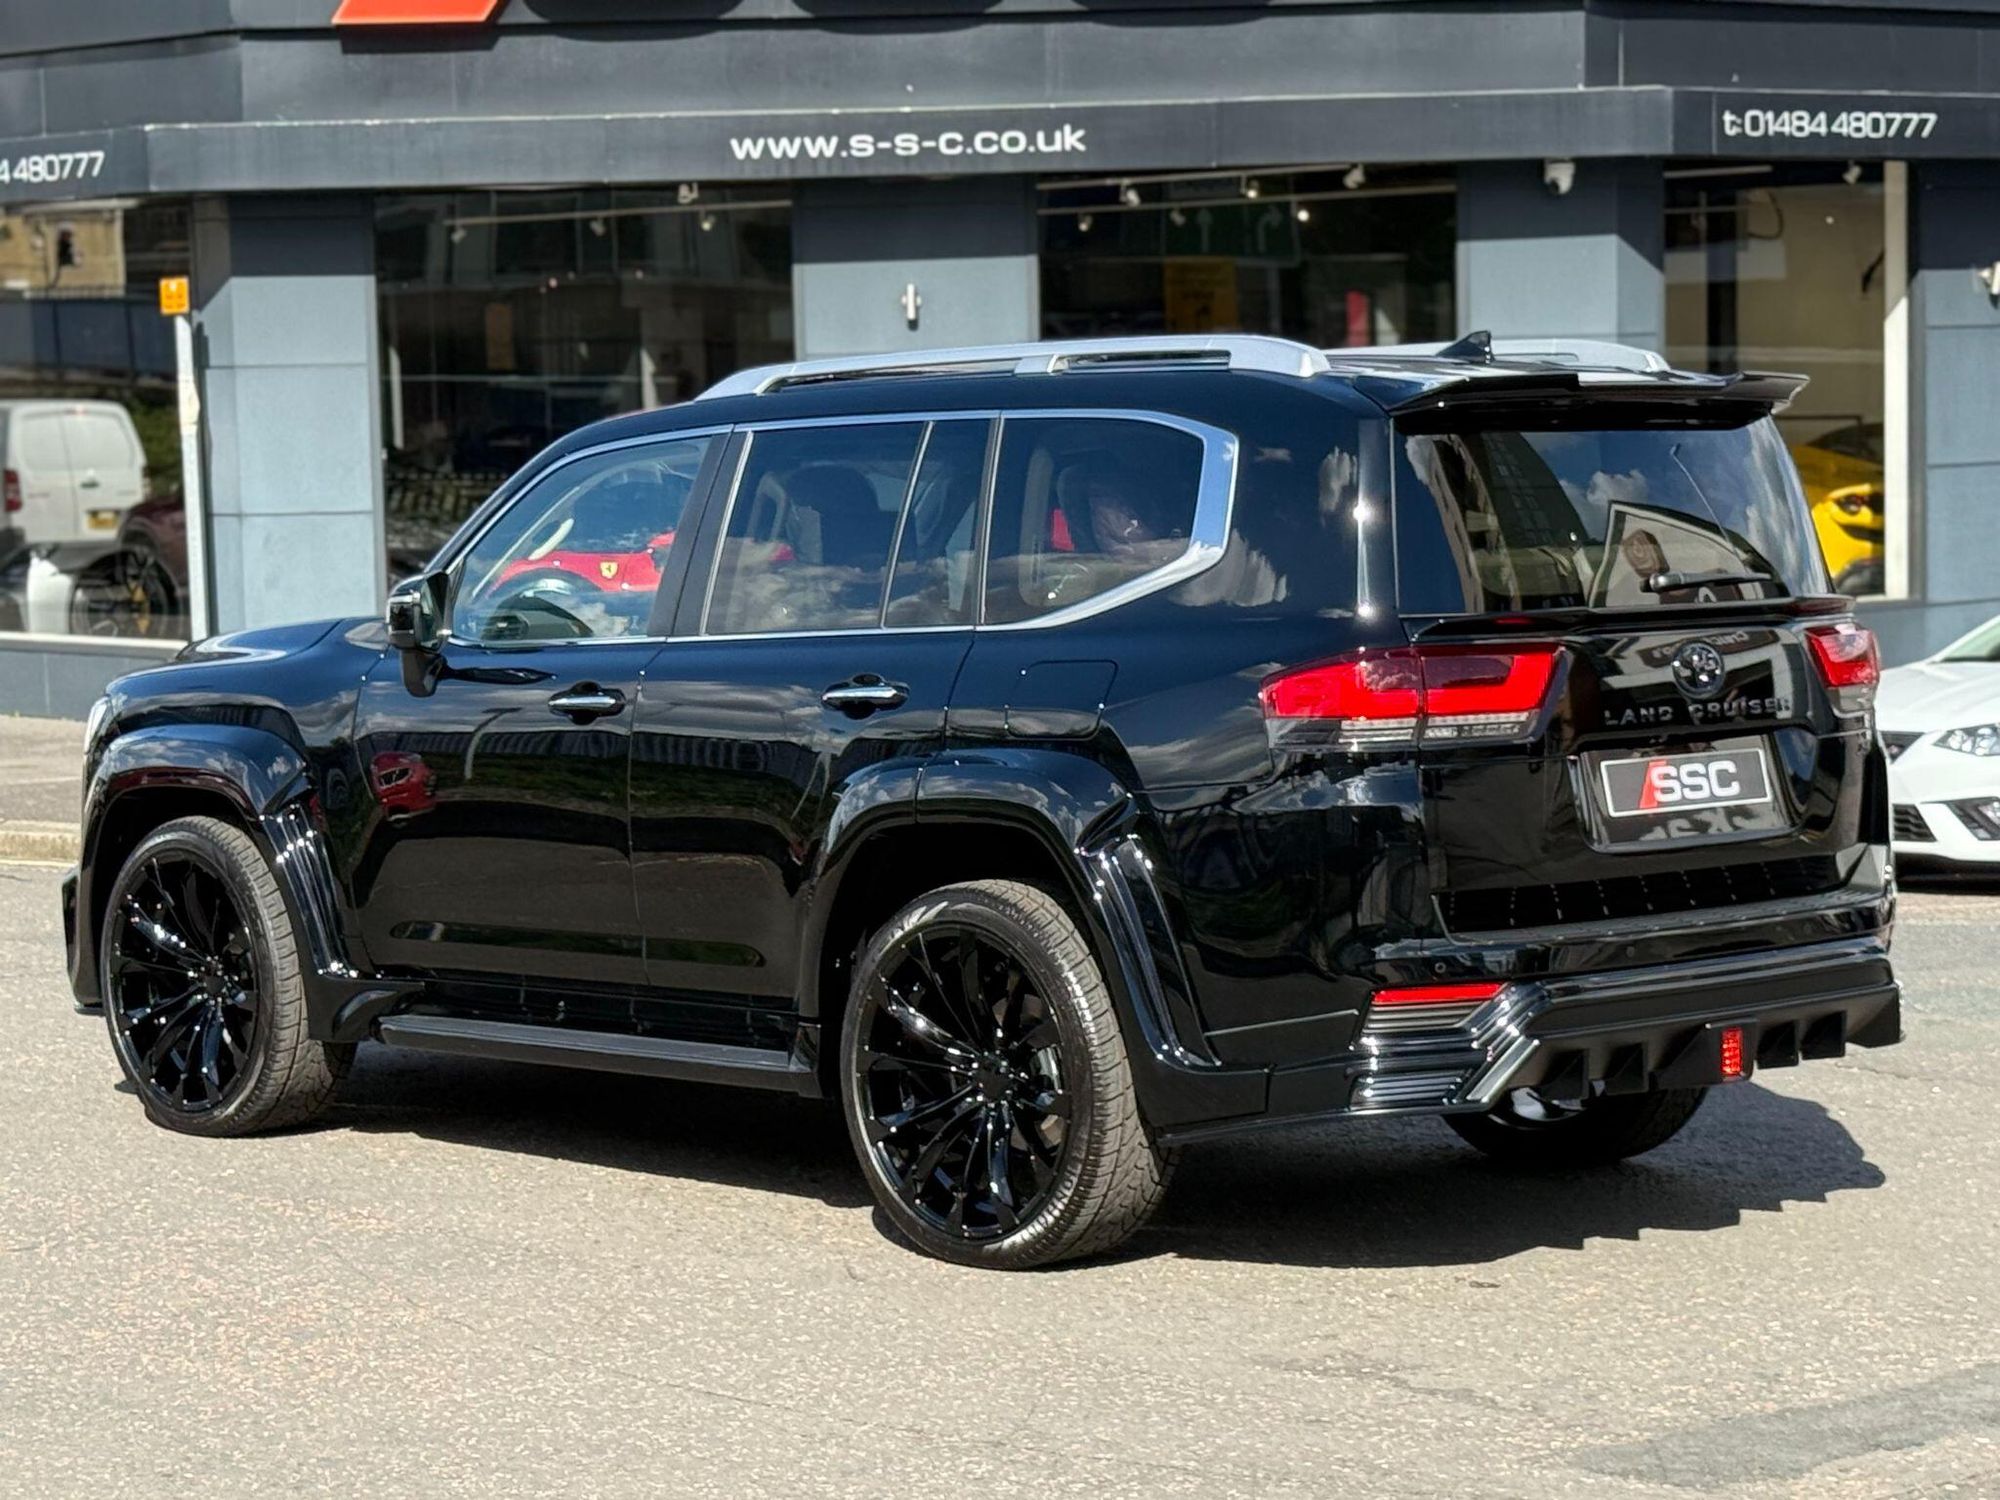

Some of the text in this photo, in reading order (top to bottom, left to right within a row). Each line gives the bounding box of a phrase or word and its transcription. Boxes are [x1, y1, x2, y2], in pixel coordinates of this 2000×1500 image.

[730, 123, 1086, 160] www.s-s-c.co.uk
[1830, 111, 1938, 139] 480777
[12, 149, 105, 184] 480777
[1604, 697, 1791, 726] LAND CRUISER
[1651, 760, 1741, 803] SSC
